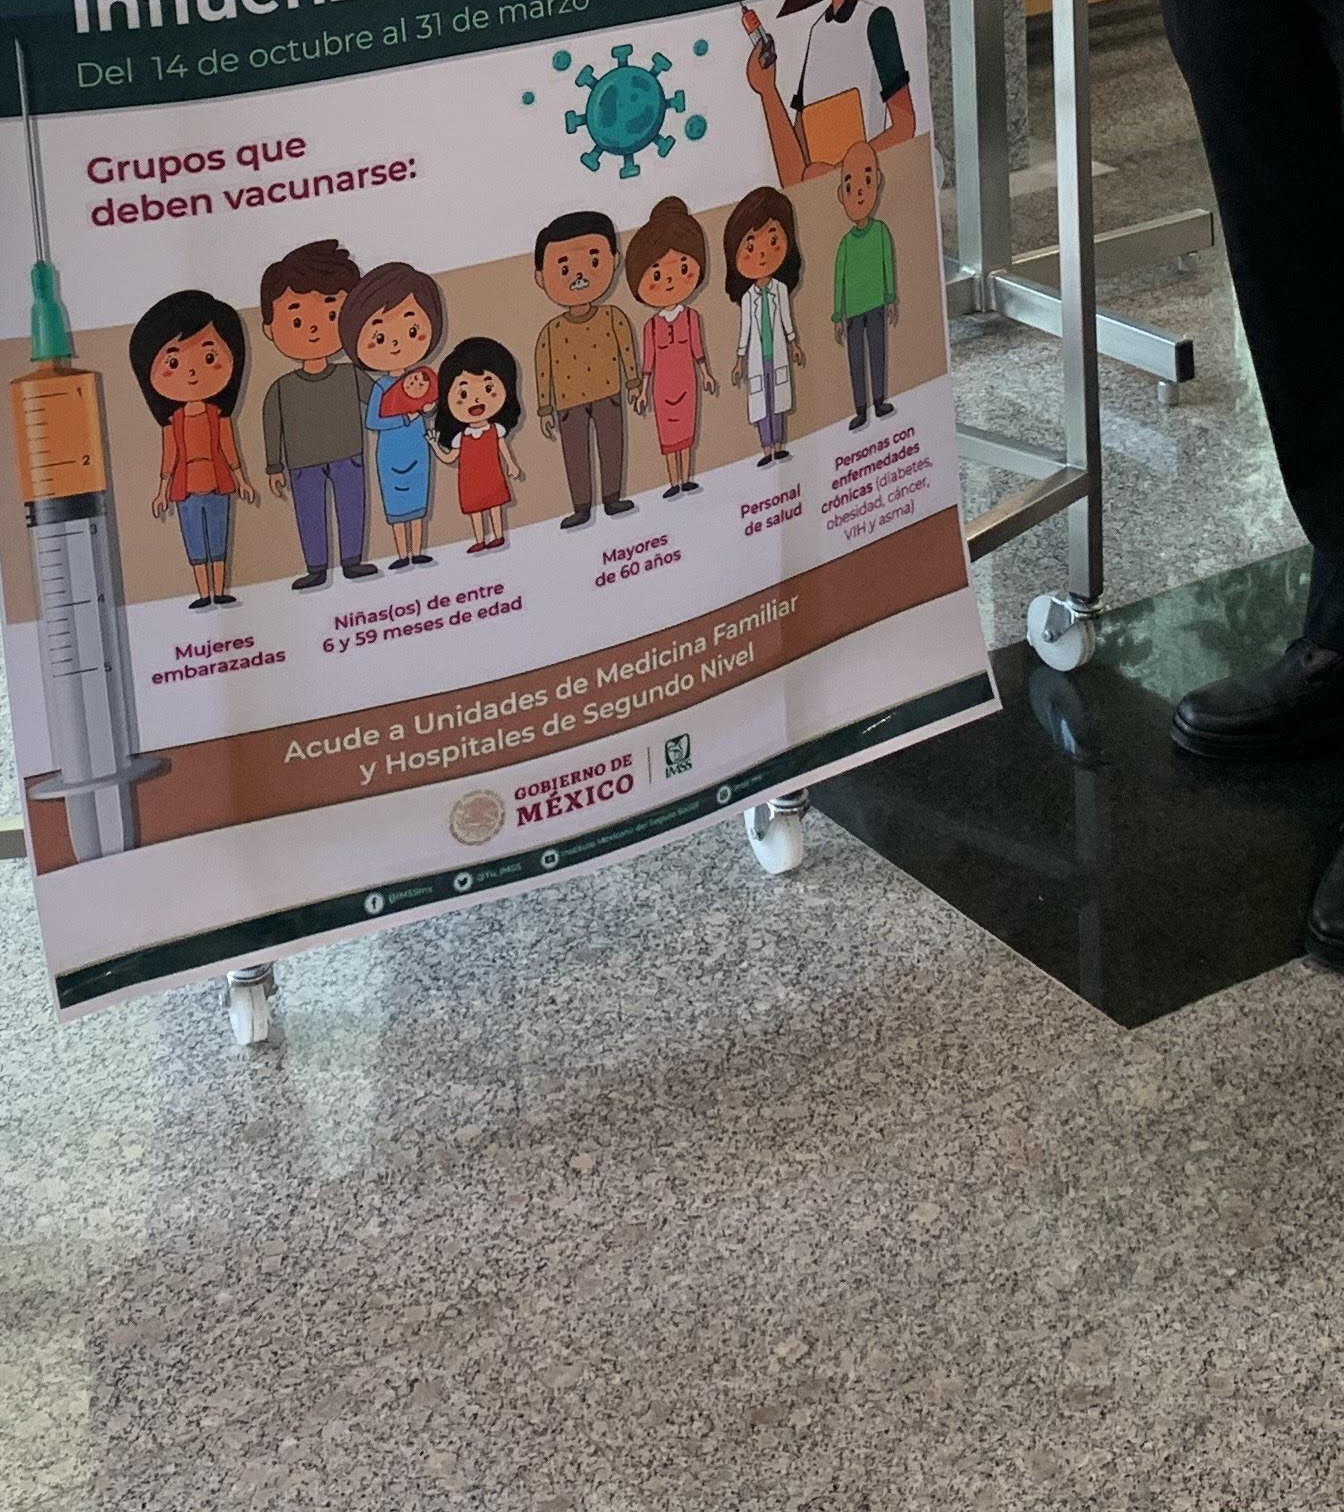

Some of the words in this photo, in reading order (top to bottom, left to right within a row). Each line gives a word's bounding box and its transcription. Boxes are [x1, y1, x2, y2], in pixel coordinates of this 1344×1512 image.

[77, 57, 133, 88] Del
[151, 54, 188, 81] 14
[197, 48, 239, 76] de
[249, 31, 373, 68] octubre
[383, 17, 407, 45] al
[415, 12, 442, 39] 31
[452, 6, 489, 33] de
[87, 148, 225, 184] Grupos
[236, 137, 306, 171] que
[91, 192, 213, 226] deben
[223, 158, 417, 210] vacunarse:
[831, 442, 920, 490] enfermedades
[835, 441, 890, 471] Personas
[893, 426, 915, 444] con
[741, 483, 801, 518] Personal
[821, 482, 873, 514] crónicas
[876, 456, 933, 491] (diabetes,
[826, 495, 885, 530] obesidad,
[888, 476, 930, 504] cáncer,
[744, 519, 762, 537] de
[765, 502, 802, 529] salud
[844, 521, 867, 541] VIH
[867, 519, 877, 534] y
[878, 498, 915, 527] asma)
[595, 571, 616, 587] de
[620, 561, 640, 579] 60
[644, 550, 681, 571] años
[602, 534, 668, 565] Mayores
[322, 637, 335, 653] 6
[339, 636, 351, 653] y
[354, 630, 378, 647] 59
[383, 618, 444, 641] meses
[449, 609, 473, 627] de
[477, 596, 523, 619] edad
[335, 599, 421, 630] Niñas(os)
[427, 594, 451, 611] de
[455, 582, 505, 604] entre
[151, 648, 286, 685] embarazadas
[174, 635, 255, 661] Mujeres
[284, 727, 380, 764] Acude
[389, 723, 404, 741] a
[413, 687, 548, 735] Unidades
[555, 675, 588, 700] de
[596, 636, 706, 688] Medicina
[713, 594, 799, 645] Familiar
[359, 761, 377, 786] y
[385, 724, 535, 775] Hospitales
[542, 712, 576, 736] de
[583, 672, 694, 724] Segundo
[701, 642, 755, 682] Nivel
[514, 763, 606, 800] GOBIERNO
[611, 753, 633, 772] DE
[665, 759, 693, 779] IMSS
[516, 774, 634, 827] MÉXICO
